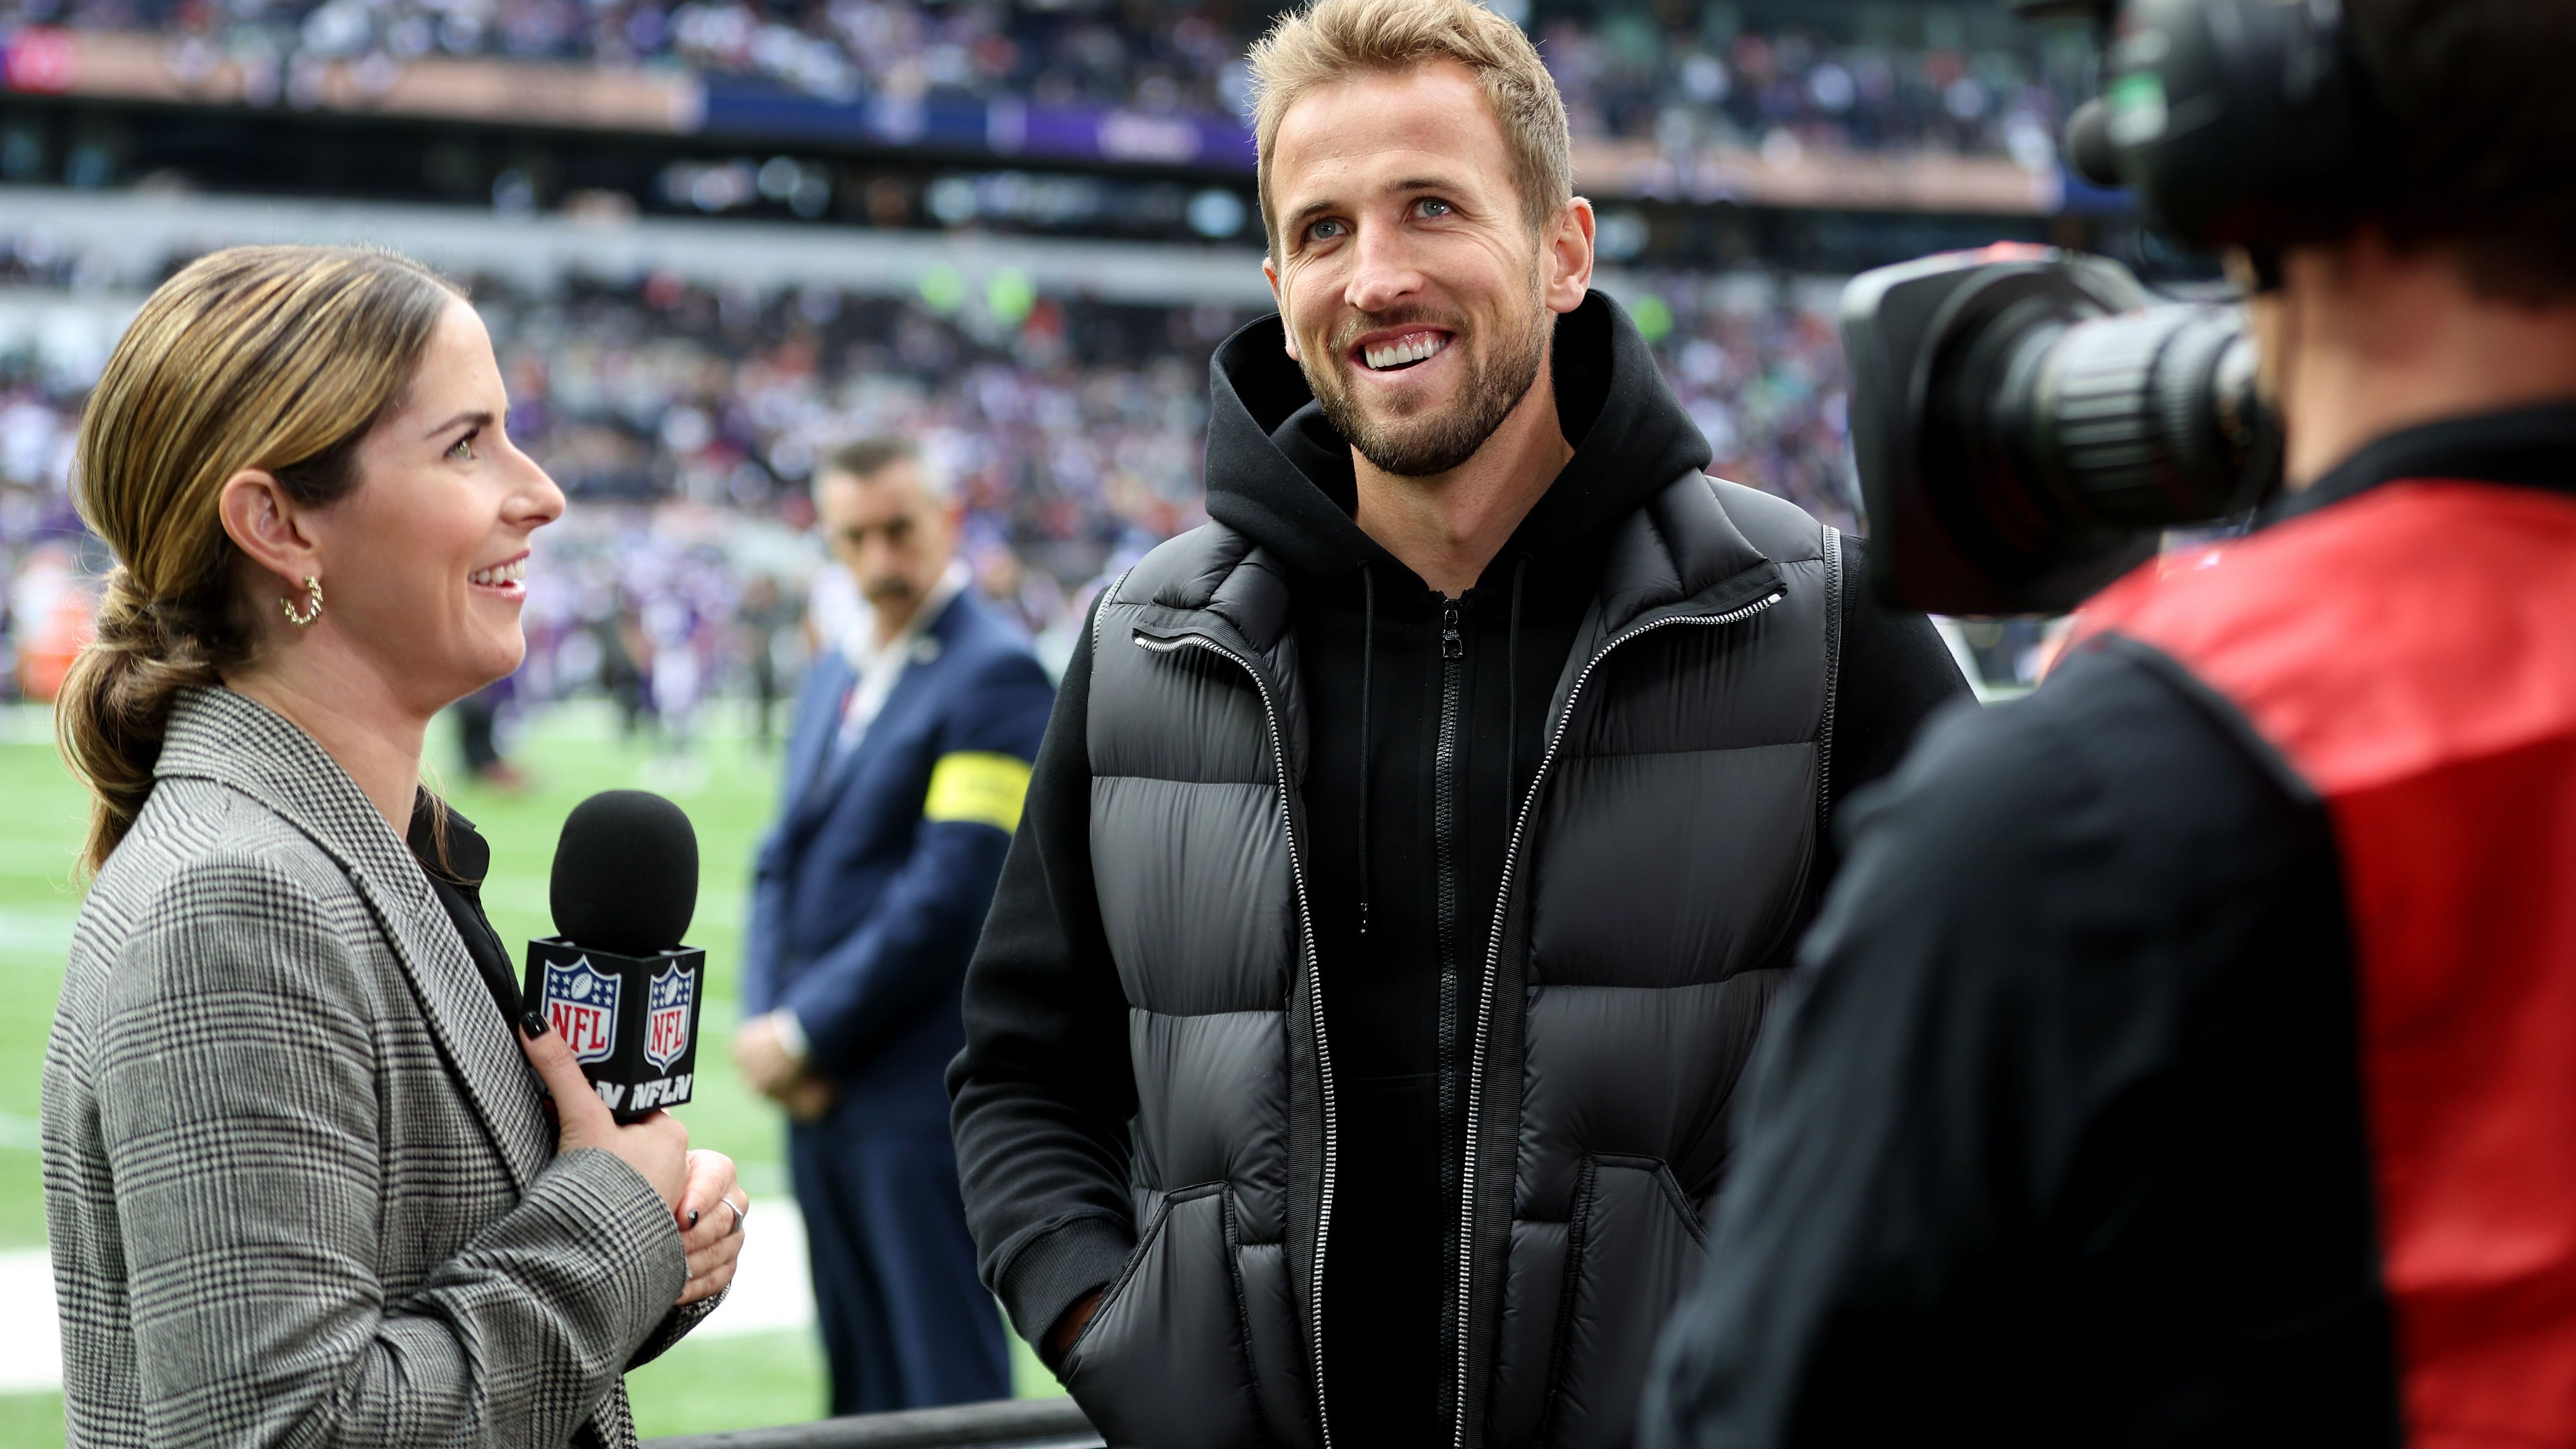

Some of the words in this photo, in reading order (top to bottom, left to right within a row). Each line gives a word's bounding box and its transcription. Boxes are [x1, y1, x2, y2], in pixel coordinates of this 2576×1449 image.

[552, 1003, 605, 1053] NFL
[651, 1010, 682, 1057] NFL
[629, 1073, 692, 1111] NFLN
